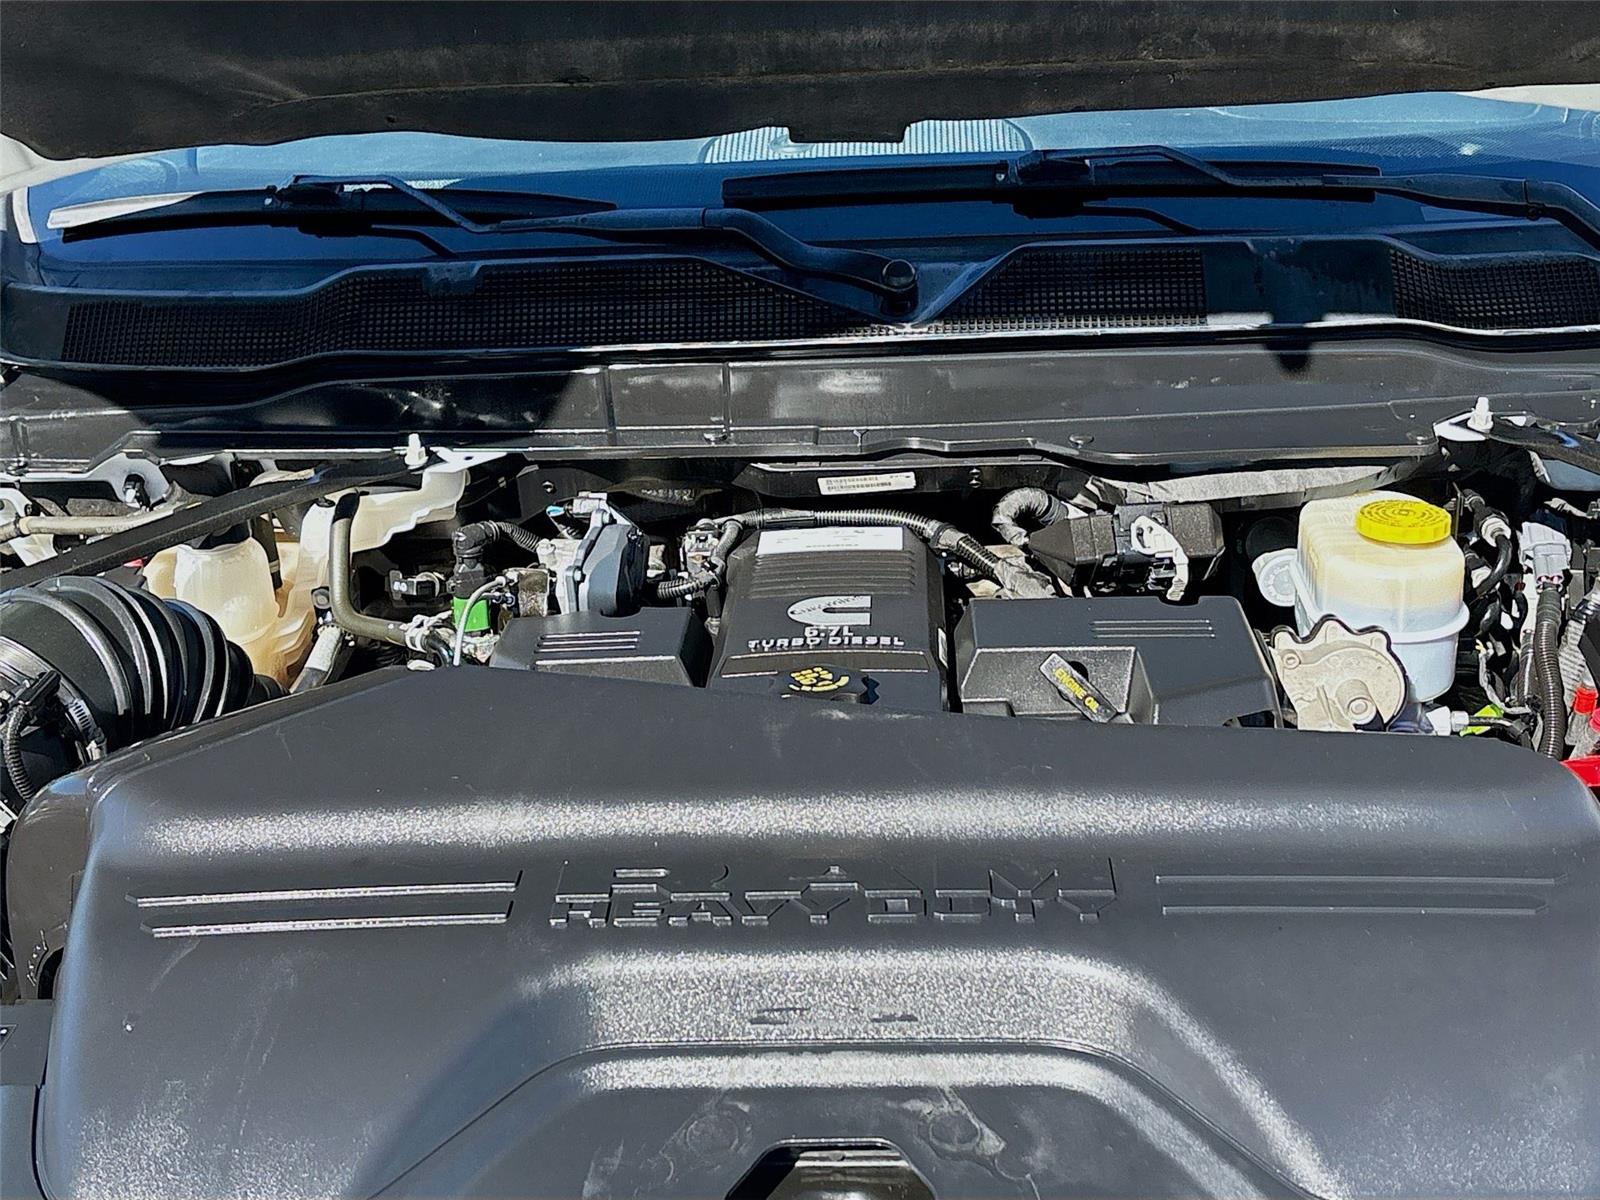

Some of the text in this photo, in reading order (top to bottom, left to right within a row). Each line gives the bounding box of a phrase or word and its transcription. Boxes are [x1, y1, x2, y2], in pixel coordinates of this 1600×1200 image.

[748, 635, 905, 649] TURBO DIESEL
[1055, 668, 1099, 713] ENGINE OIL
